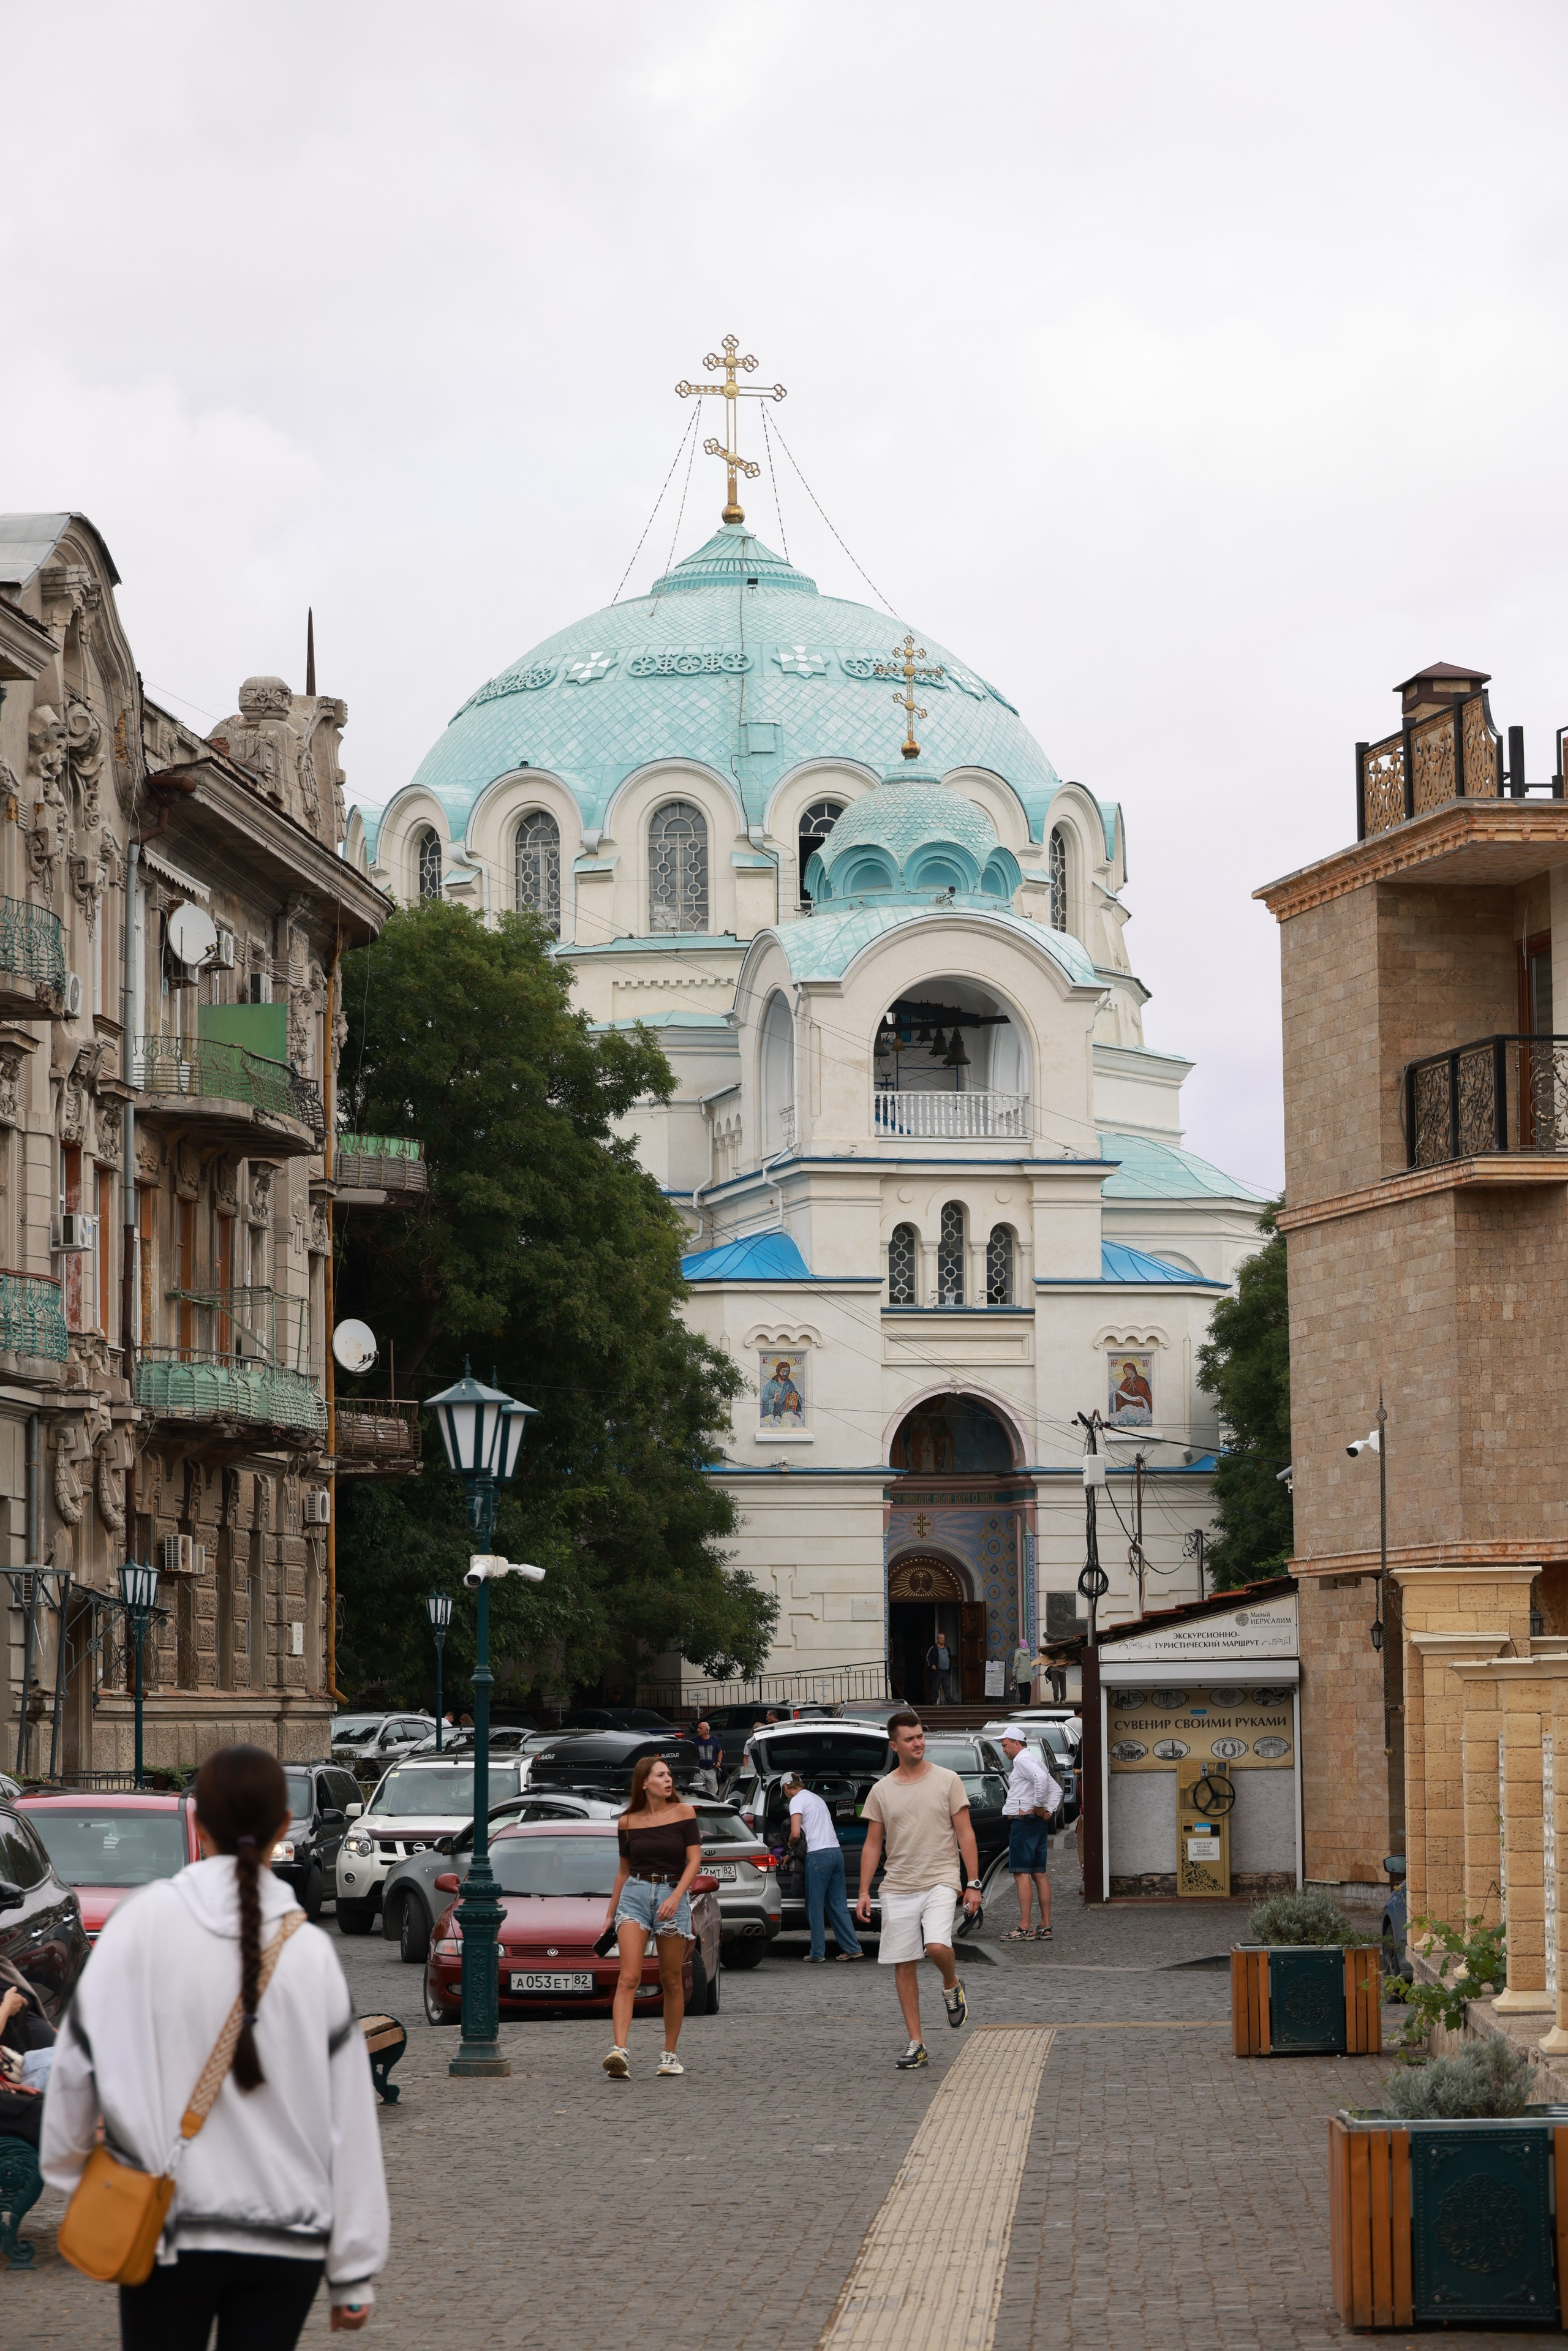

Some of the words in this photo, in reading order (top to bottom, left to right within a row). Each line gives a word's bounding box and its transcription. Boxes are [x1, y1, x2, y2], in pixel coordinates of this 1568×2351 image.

[1154, 1640, 1220, 1649] ТУРИСТИЧЕСКИЙ
[1114, 1719, 1171, 1730] СУВЕНИР
[1175, 1718, 1231, 1729] СВОИМИ
[1235, 1716, 1286, 1727] РУКАМИ
[723, 1866, 733, 1874] 82
[574, 1975, 588, 1985] 82
